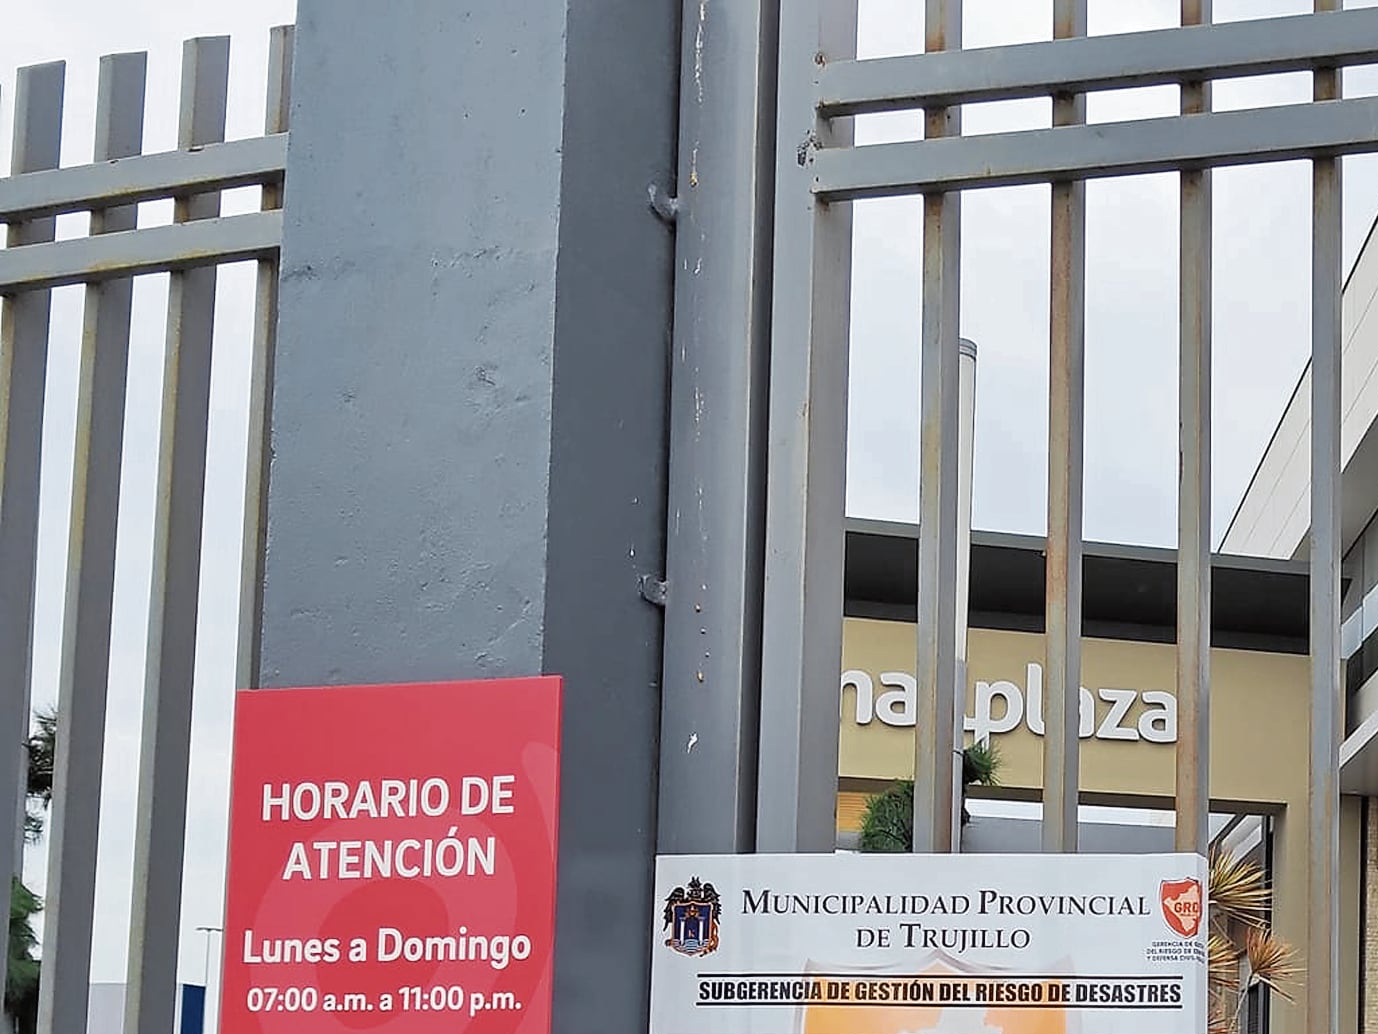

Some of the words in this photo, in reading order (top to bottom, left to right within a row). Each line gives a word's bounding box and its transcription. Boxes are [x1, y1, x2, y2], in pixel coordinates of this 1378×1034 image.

[262, 777, 450, 822] HORARIO
[461, 774, 516, 815] DE
[282, 826, 496, 880] ATENCIÓN
[243, 929, 340, 963] Lunes
[348, 937, 367, 962] a
[377, 926, 532, 969] Domingo
[246, 986, 318, 1013] 07:00
[322, 992, 374, 1012] a.m.
[380, 992, 392, 1011] a
[399, 985, 464, 1011] 11:00
[469, 989, 522, 1017] p.m.
[699, 980, 823, 1001] SUBGERENCIA
[827, 981, 850, 1001] DE
[855, 979, 934, 1001] GESTIÓN
[940, 982, 970, 1001] DEL
[975, 983, 1043, 1002] RIESGO
[1047, 983, 1071, 1002] DE
[1075, 983, 1182, 1003] DESASTRES
